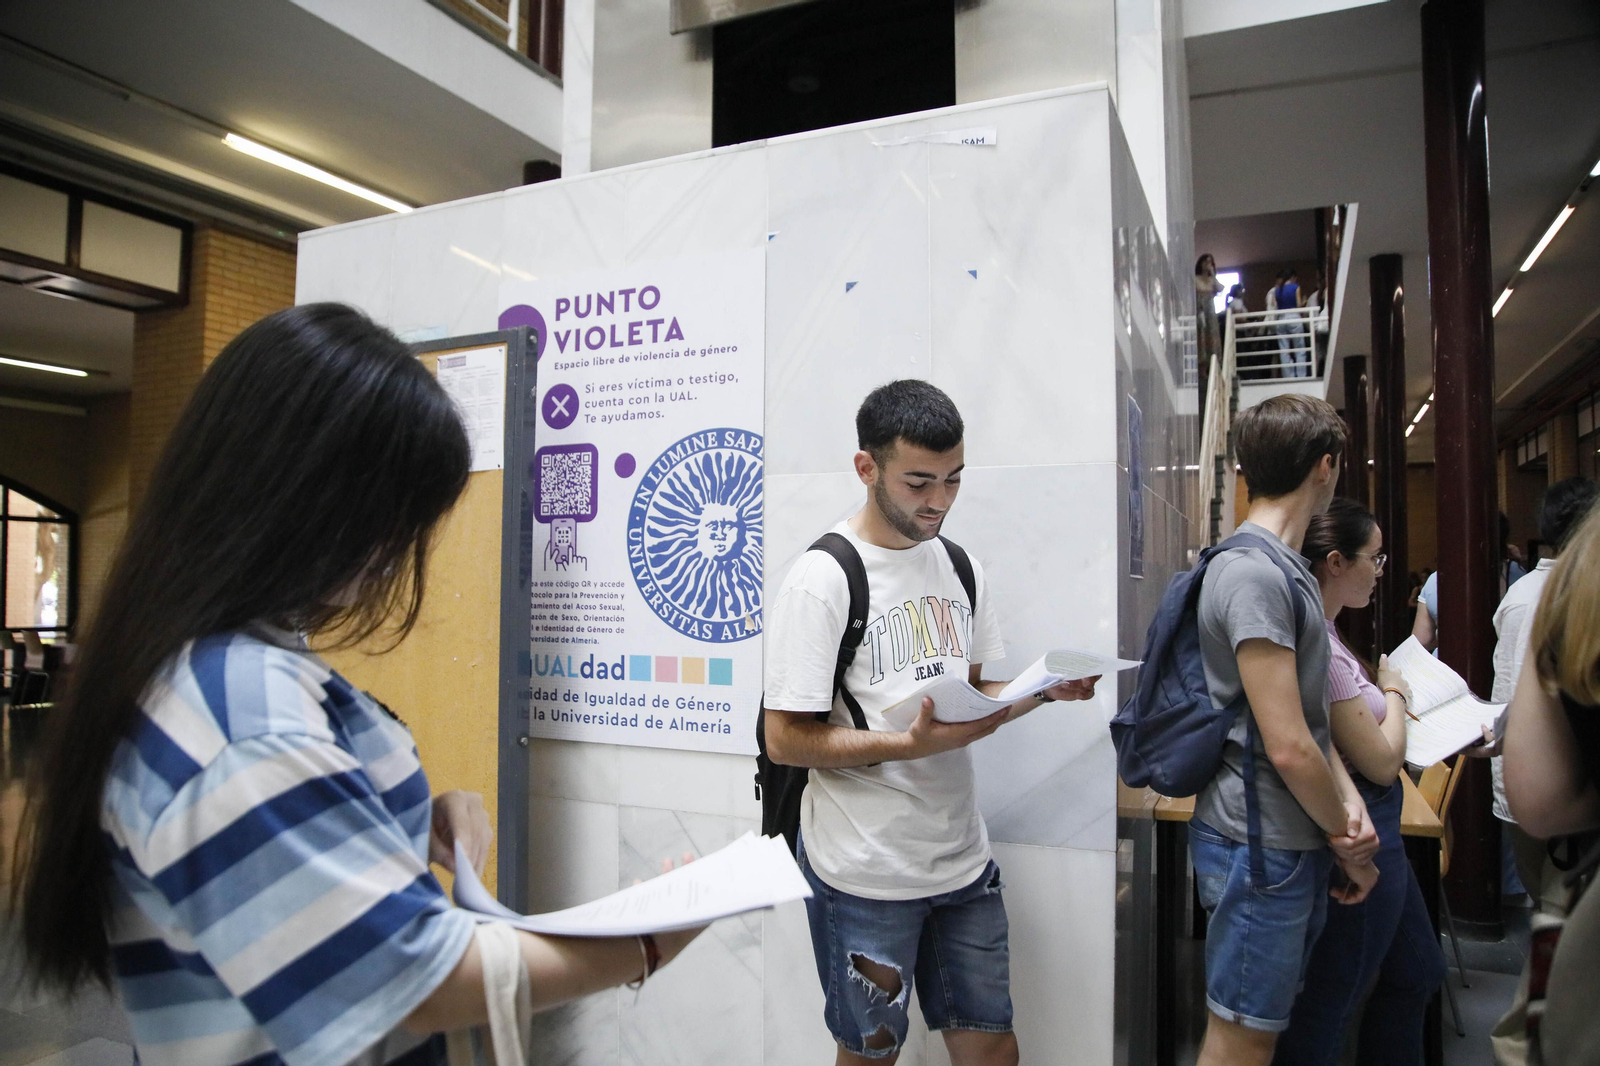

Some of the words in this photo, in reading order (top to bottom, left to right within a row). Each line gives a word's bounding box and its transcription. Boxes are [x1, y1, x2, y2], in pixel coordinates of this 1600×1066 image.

[556, 285, 660, 321] PUNTO
[554, 316, 684, 354] VIOLETA
[554, 360, 589, 371] Espacio
[593, 357, 614, 366] libre
[619, 354, 630, 363] de
[634, 350, 680, 362] violencia
[684, 346, 696, 356] de
[700, 344, 738, 357] género
[585, 383, 595, 394] Si
[600, 383, 623, 392] eres
[628, 378, 672, 390] víctima
[689, 372, 739, 385] testigo,
[584, 397, 624, 408] cuenta
[628, 395, 650, 404] con
[654, 392, 665, 403] la
[670, 391, 698, 402] UAL.
[584, 414, 597, 423] Te
[601, 410, 665, 424] ayudamos.
[634, 486, 653, 510] IN
[647, 431, 718, 484] LUMINE
[628, 526, 713, 640] UNIVERSITAS
[863, 596, 972, 685] TOMMY
[530, 654, 625, 681] UALdad
[915, 662, 944, 681] JEANS
[563, 689, 579, 702] de
[585, 692, 646, 707] Igualdad
[652, 695, 670, 708] de
[676, 696, 731, 712] Género
[534, 707, 545, 720] la
[551, 709, 638, 727] Universidad
[645, 715, 664, 729] de
[669, 717, 731, 734] Almería
